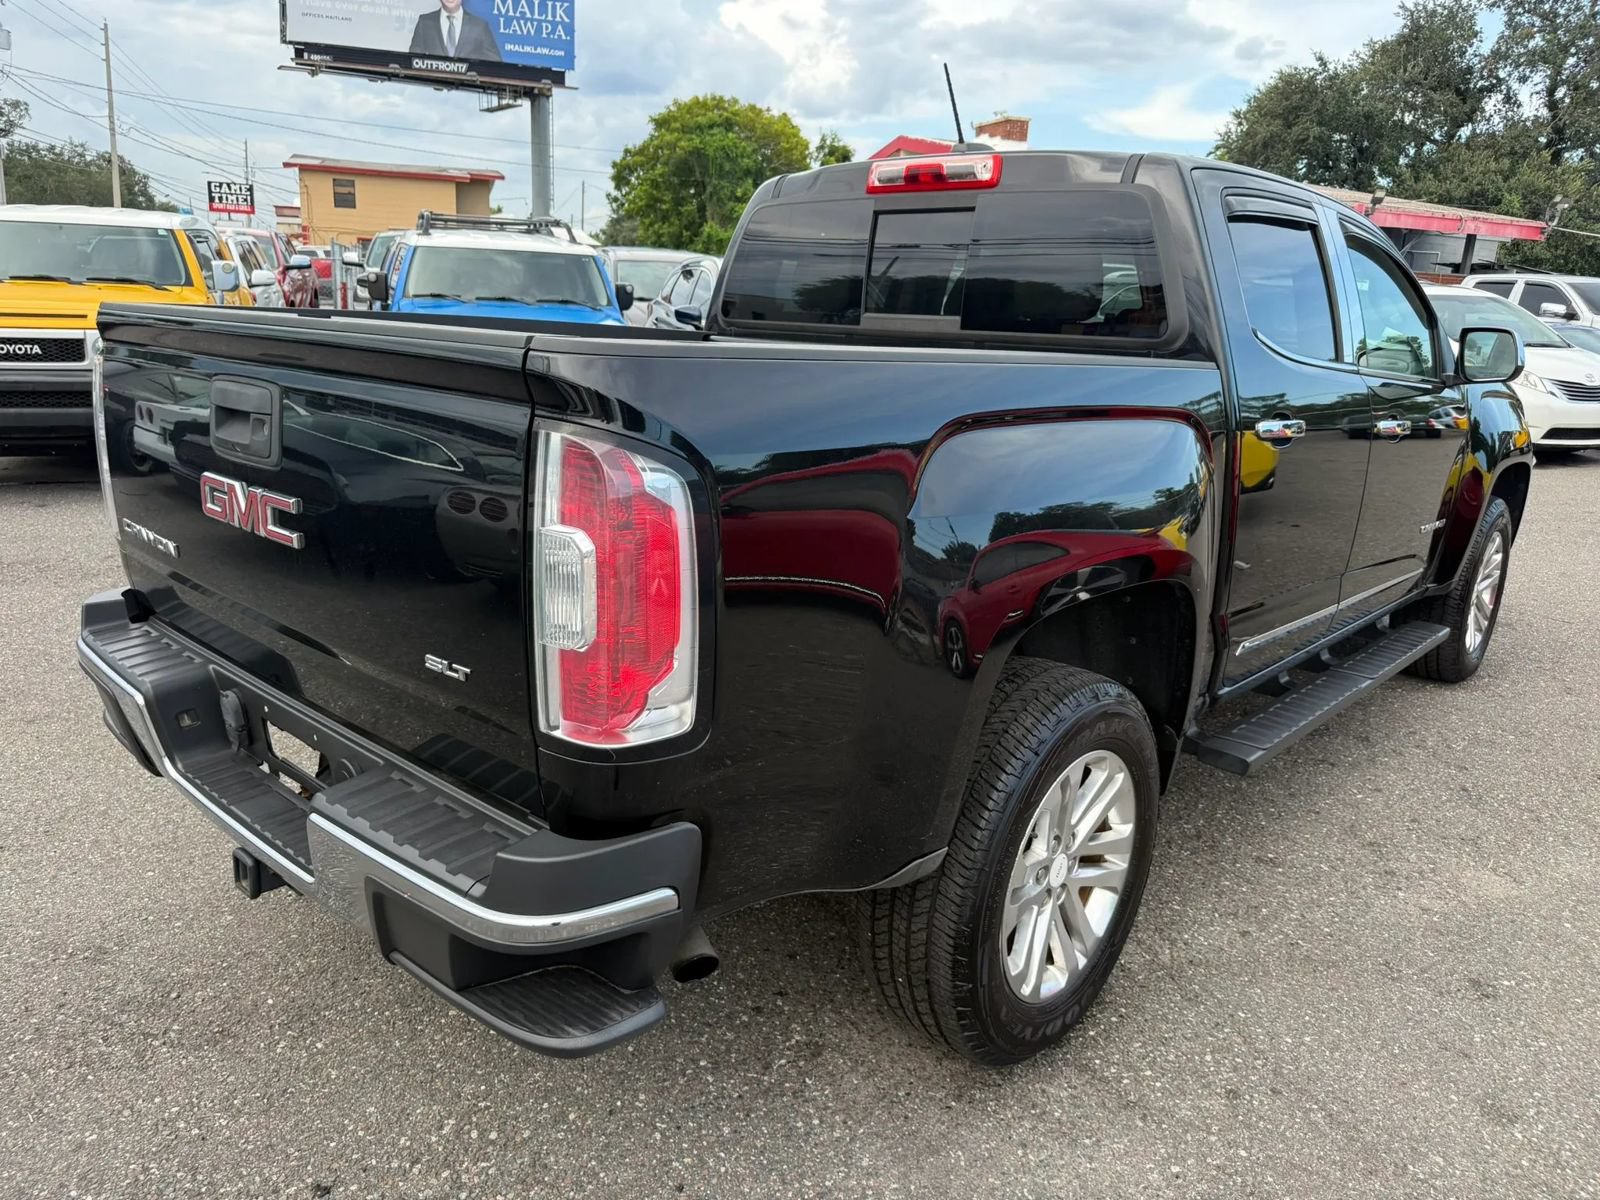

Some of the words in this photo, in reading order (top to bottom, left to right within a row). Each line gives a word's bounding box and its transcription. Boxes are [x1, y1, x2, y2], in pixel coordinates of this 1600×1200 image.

[493, 0, 571, 22] MALIK
[499, 17, 538, 37] LAW
[541, 22, 571, 40] P.A.
[210, 182, 250, 195] GAME
[211, 193, 251, 205] TIME!
[0, 344, 43, 355] OYOTA
[200, 471, 305, 550] GMC
[424, 653, 472, 682] SLT
